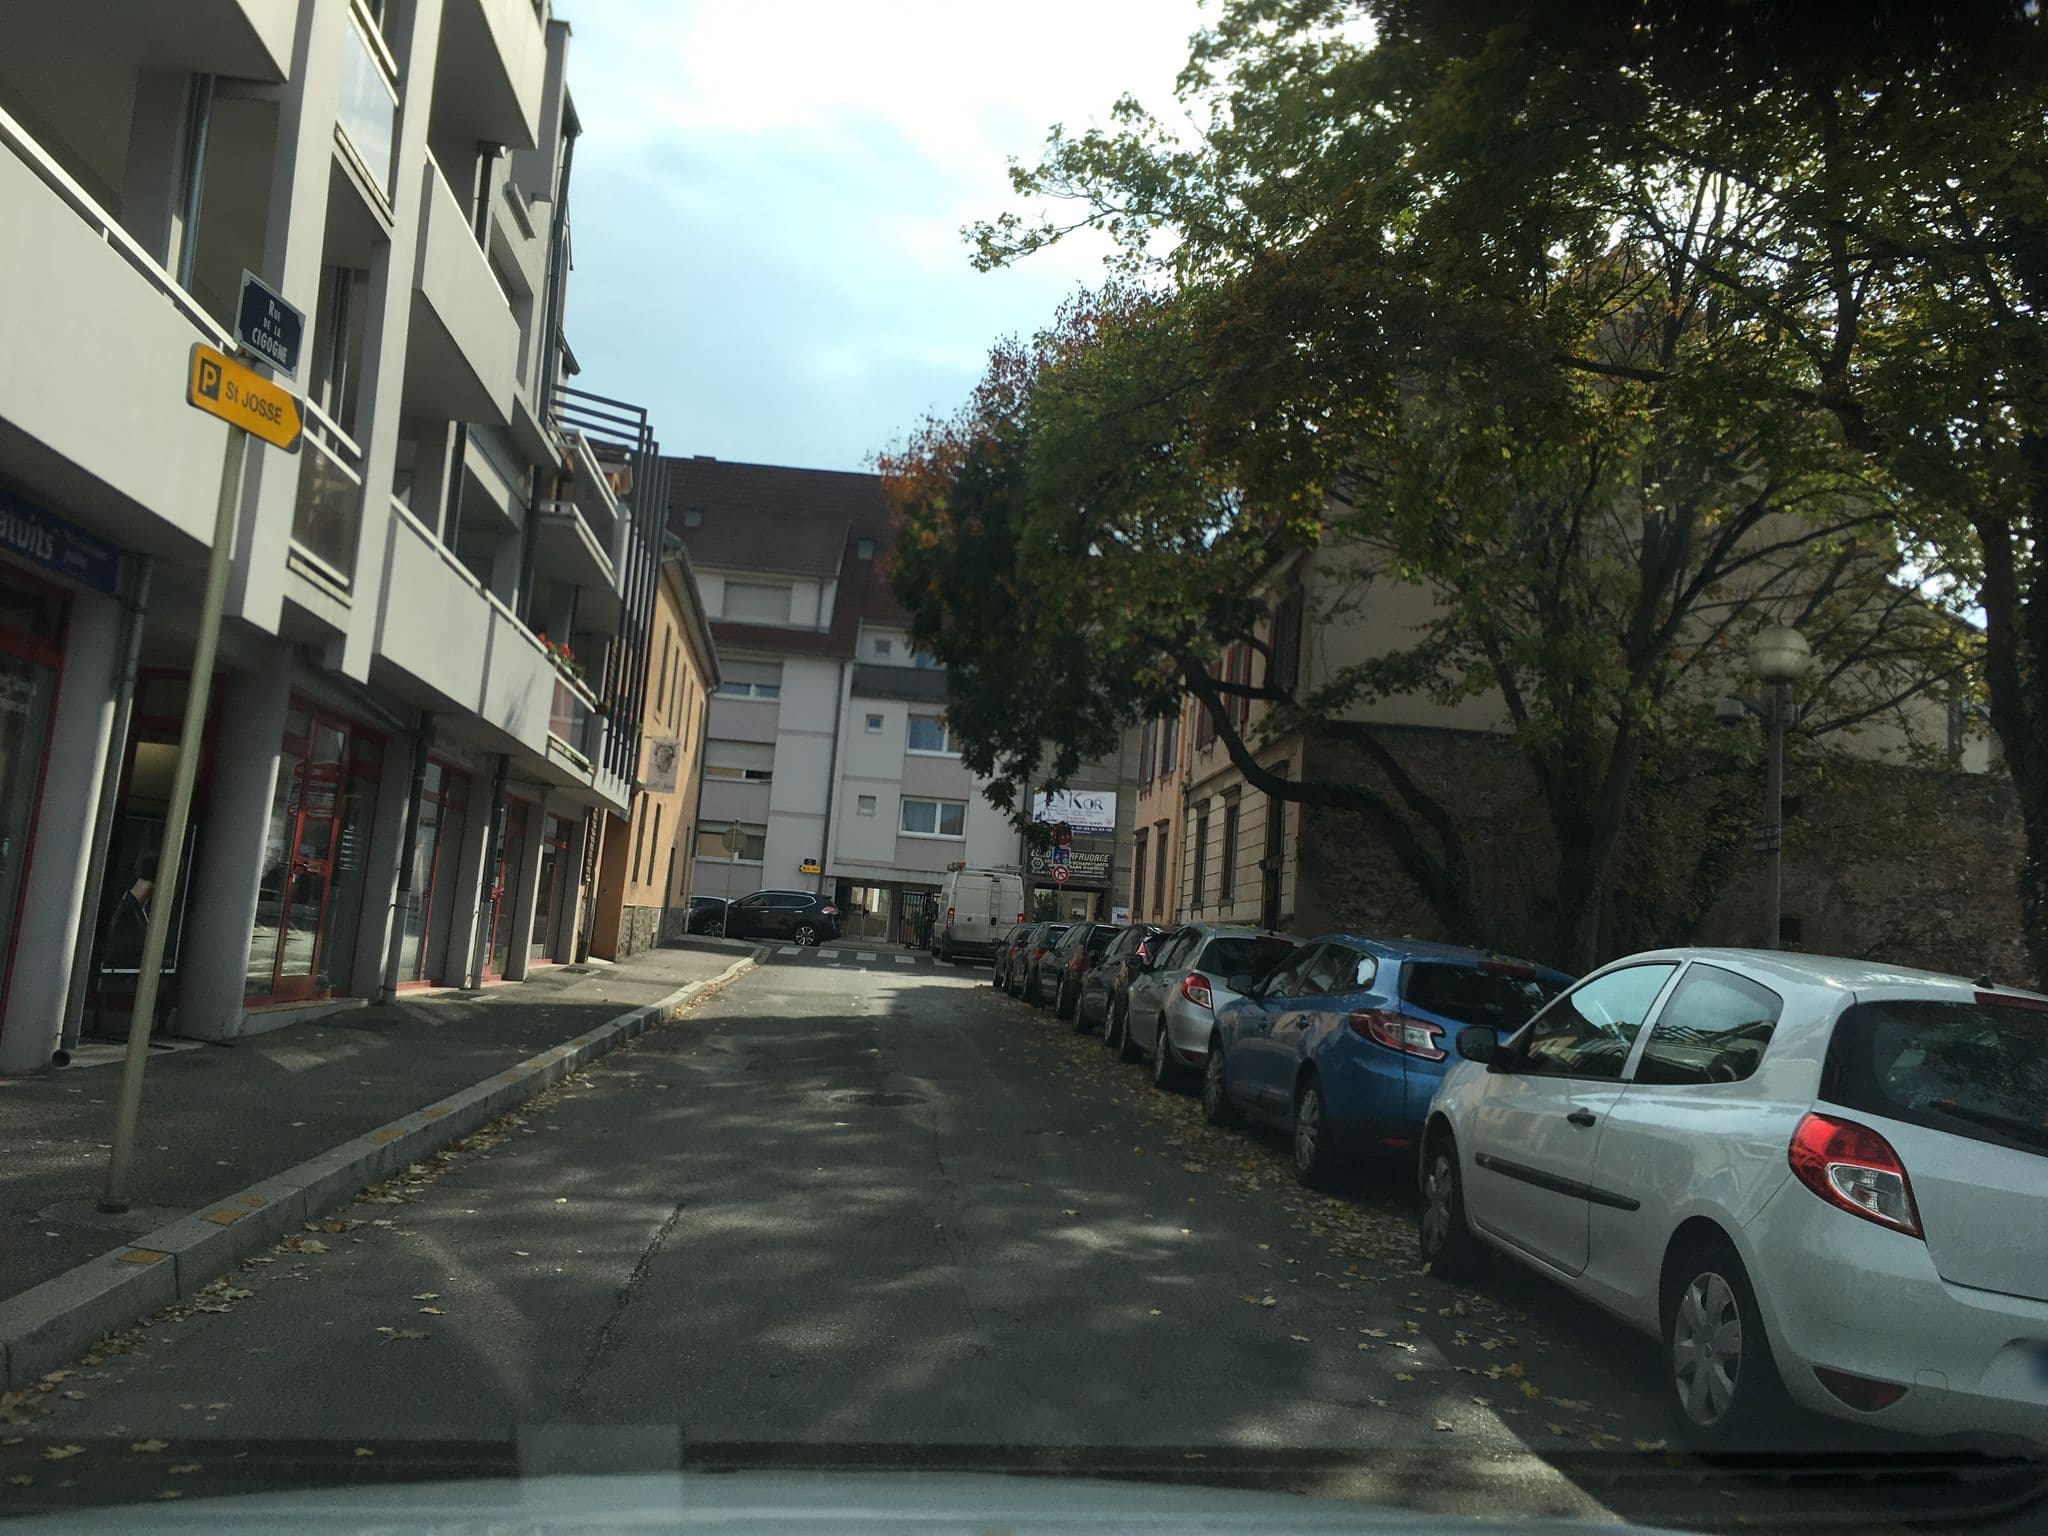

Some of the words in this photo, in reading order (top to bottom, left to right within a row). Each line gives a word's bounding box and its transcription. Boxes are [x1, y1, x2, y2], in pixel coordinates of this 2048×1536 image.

[251, 327, 288, 364] CIGOGNE
[263, 317, 271, 331] DE
[274, 325, 281, 338] LA
[202, 364, 217, 392] P
[225, 381, 239, 404] St
[241, 390, 283, 426] JOSSE
